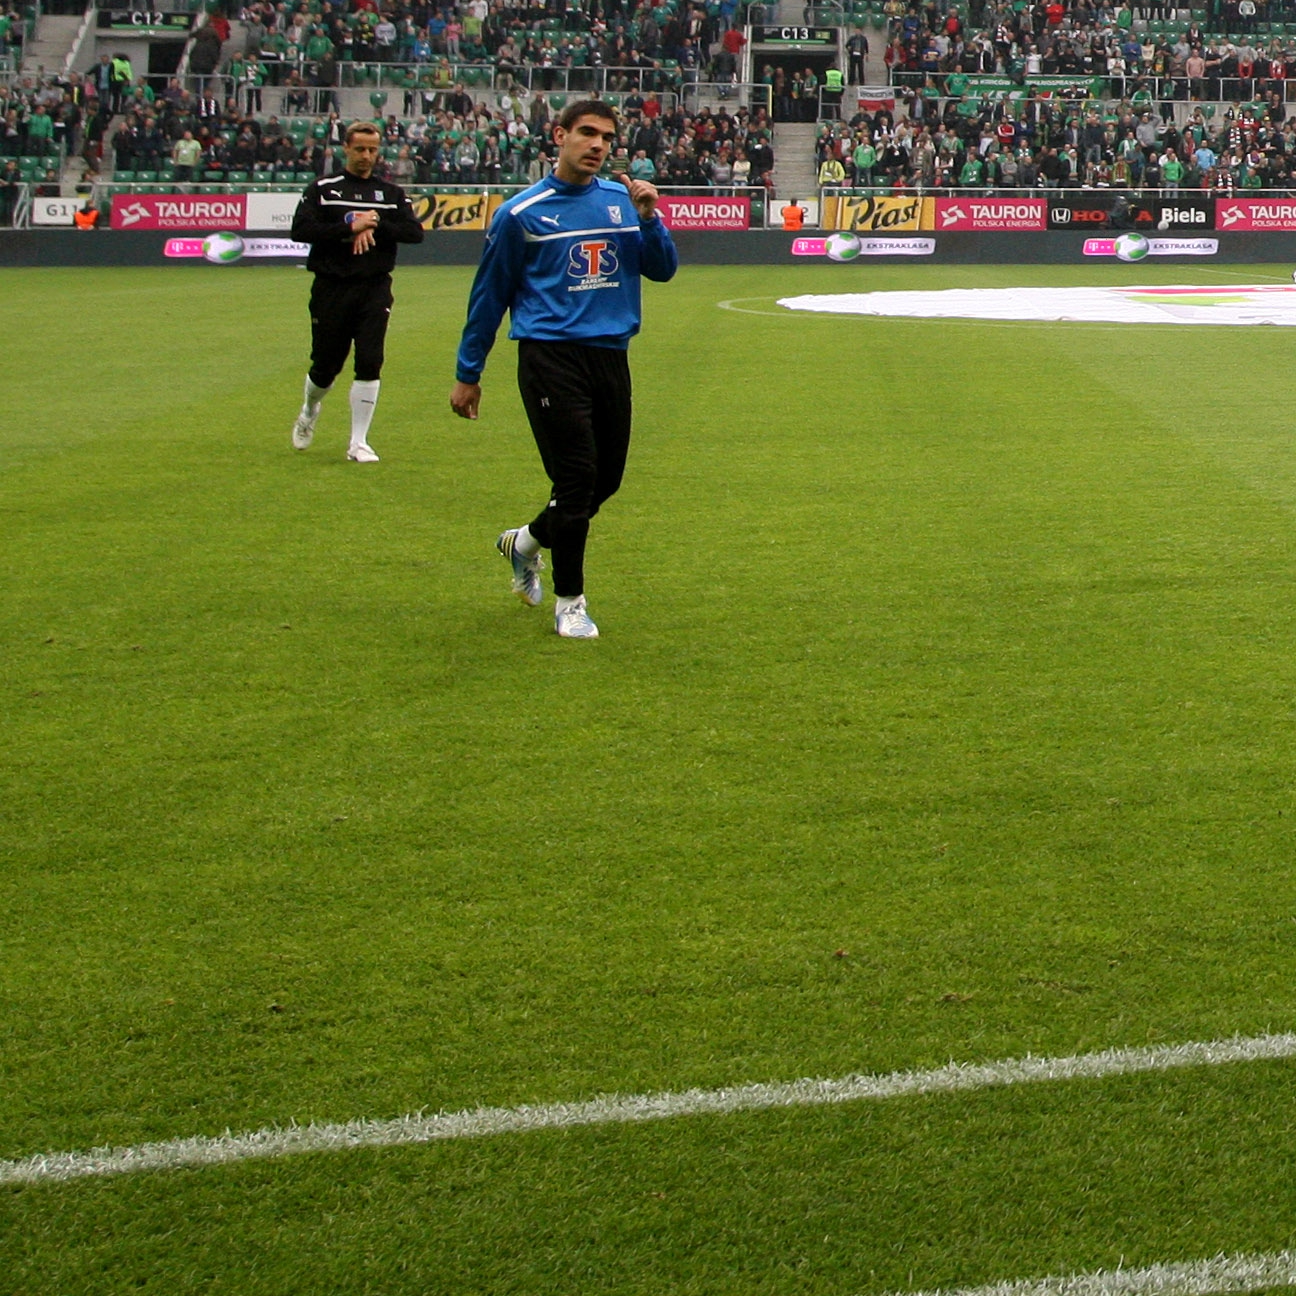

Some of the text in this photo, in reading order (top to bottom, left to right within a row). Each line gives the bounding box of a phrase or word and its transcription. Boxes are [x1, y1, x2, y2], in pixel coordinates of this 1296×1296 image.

[131, 11, 164, 25] C12
[781, 27, 809, 40] C13
[155, 202, 241, 218] TAURON
[668, 203, 745, 219] TAURON
[848, 197, 919, 230] Piast
[970, 205, 1042, 219] TAURON
[1072, 210, 1153, 222] HOA
[1161, 207, 1206, 223] Biela
[567, 239, 619, 279] STS
